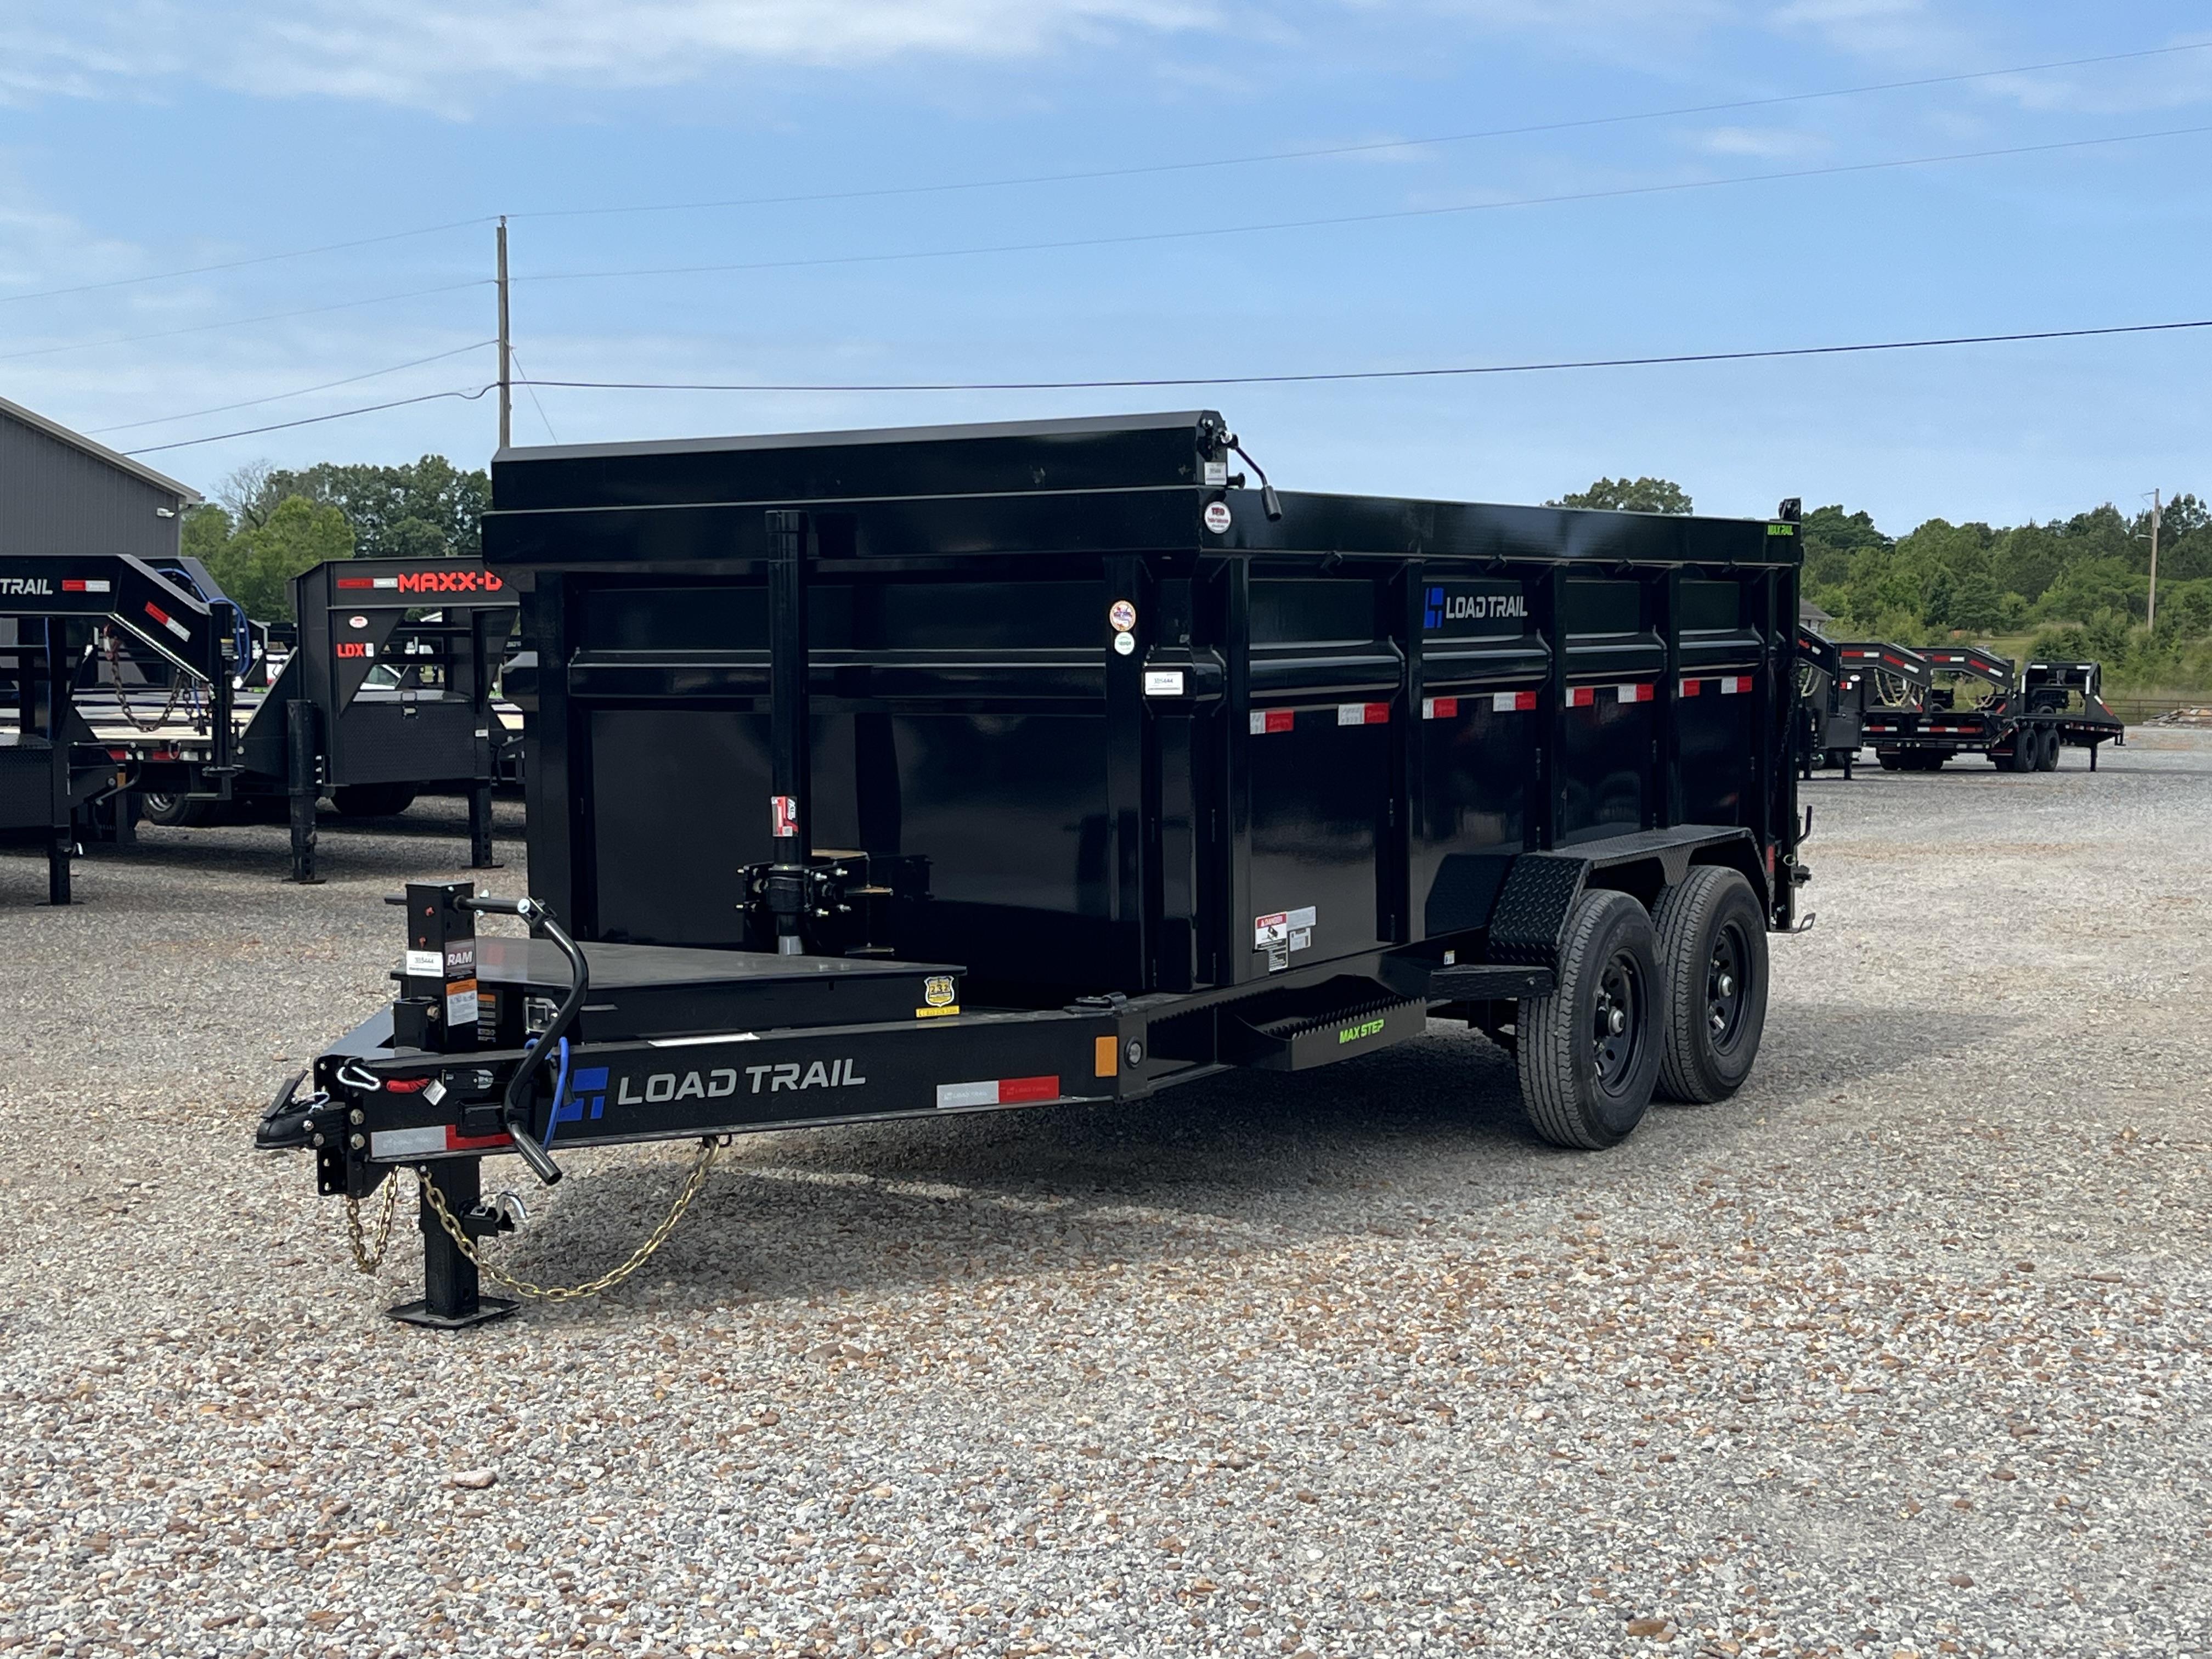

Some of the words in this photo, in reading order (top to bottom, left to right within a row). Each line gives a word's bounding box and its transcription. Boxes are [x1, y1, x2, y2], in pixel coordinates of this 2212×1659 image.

[0, 578, 53, 595] TRAIL
[1446, 596, 1486, 619] LOAD
[1487, 595, 1528, 618] TRAIL
[336, 643, 365, 658] LDX
[447, 951, 473, 966] RAM
[1339, 1025, 1361, 1044] MAX
[1361, 1018, 1384, 1037] STEP
[617, 1069, 738, 1105] LOAD
[745, 1058, 866, 1093] TRAIL
